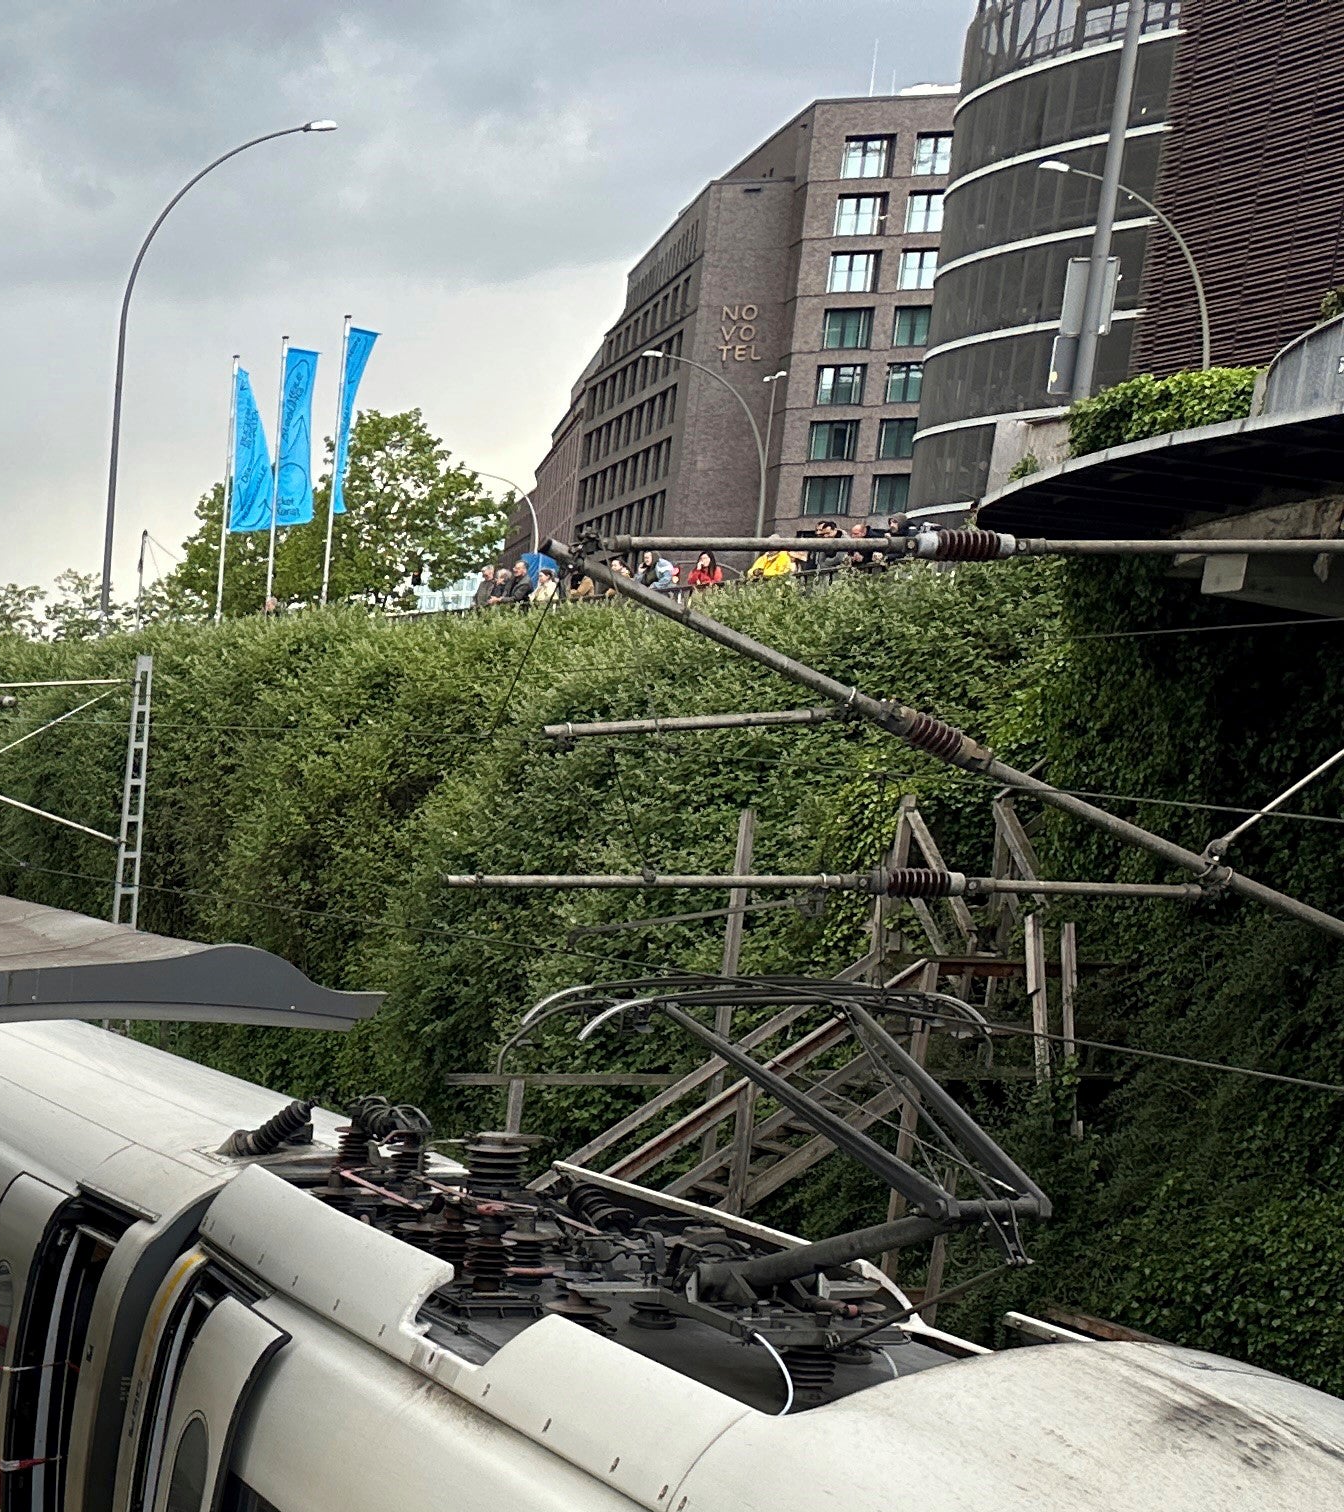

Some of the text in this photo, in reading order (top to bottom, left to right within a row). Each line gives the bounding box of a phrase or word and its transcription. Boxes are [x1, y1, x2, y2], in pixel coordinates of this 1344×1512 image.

[721, 304, 759, 322] NO
[721, 324, 756, 342] VO
[718, 344, 762, 362] TEL
